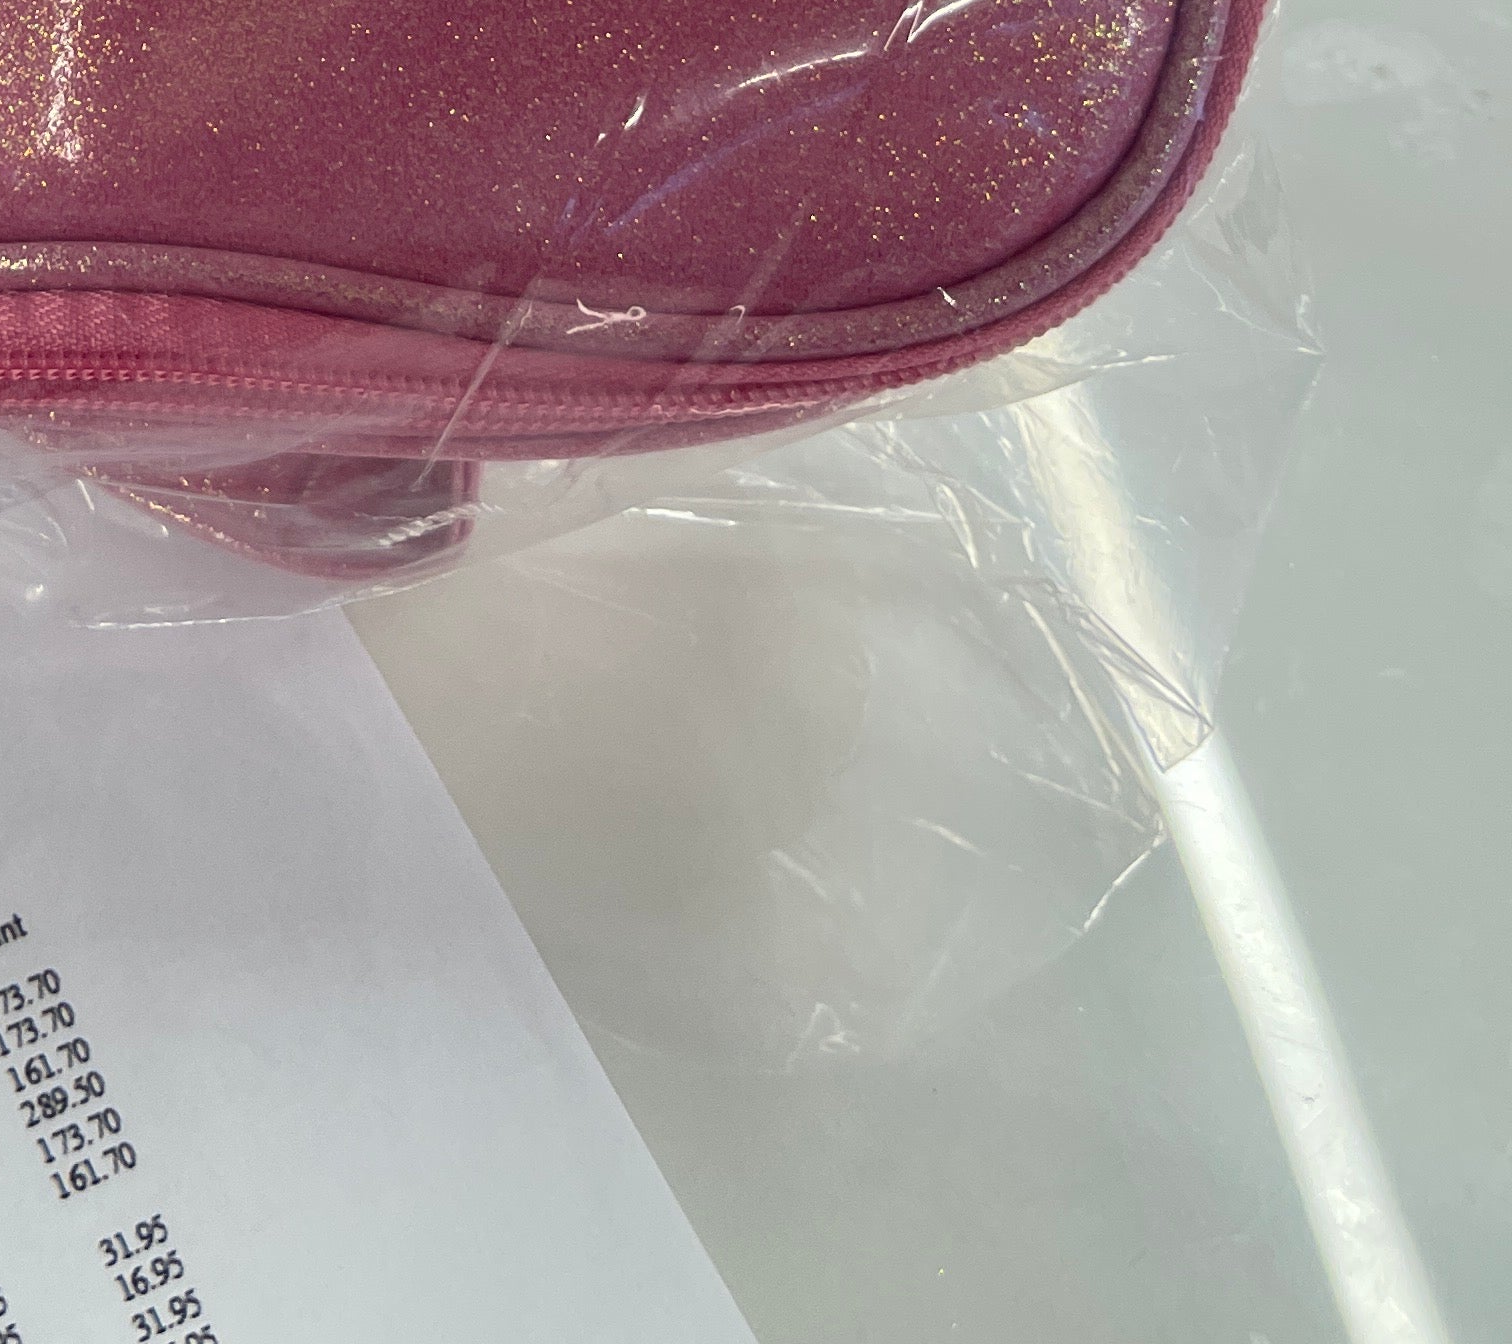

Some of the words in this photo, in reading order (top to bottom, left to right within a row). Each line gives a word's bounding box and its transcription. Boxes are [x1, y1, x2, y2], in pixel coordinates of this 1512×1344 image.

[7, 1036, 90, 1094] 161.70
[19, 1070, 106, 1129] 289.50
[37, 1107, 122, 1164] 173.70
[50, 1141, 137, 1200] 161.70
[98, 1213, 168, 1267] 31.95
[114, 1249, 185, 1302] 16.95
[132, 1287, 203, 1343] 31.95
